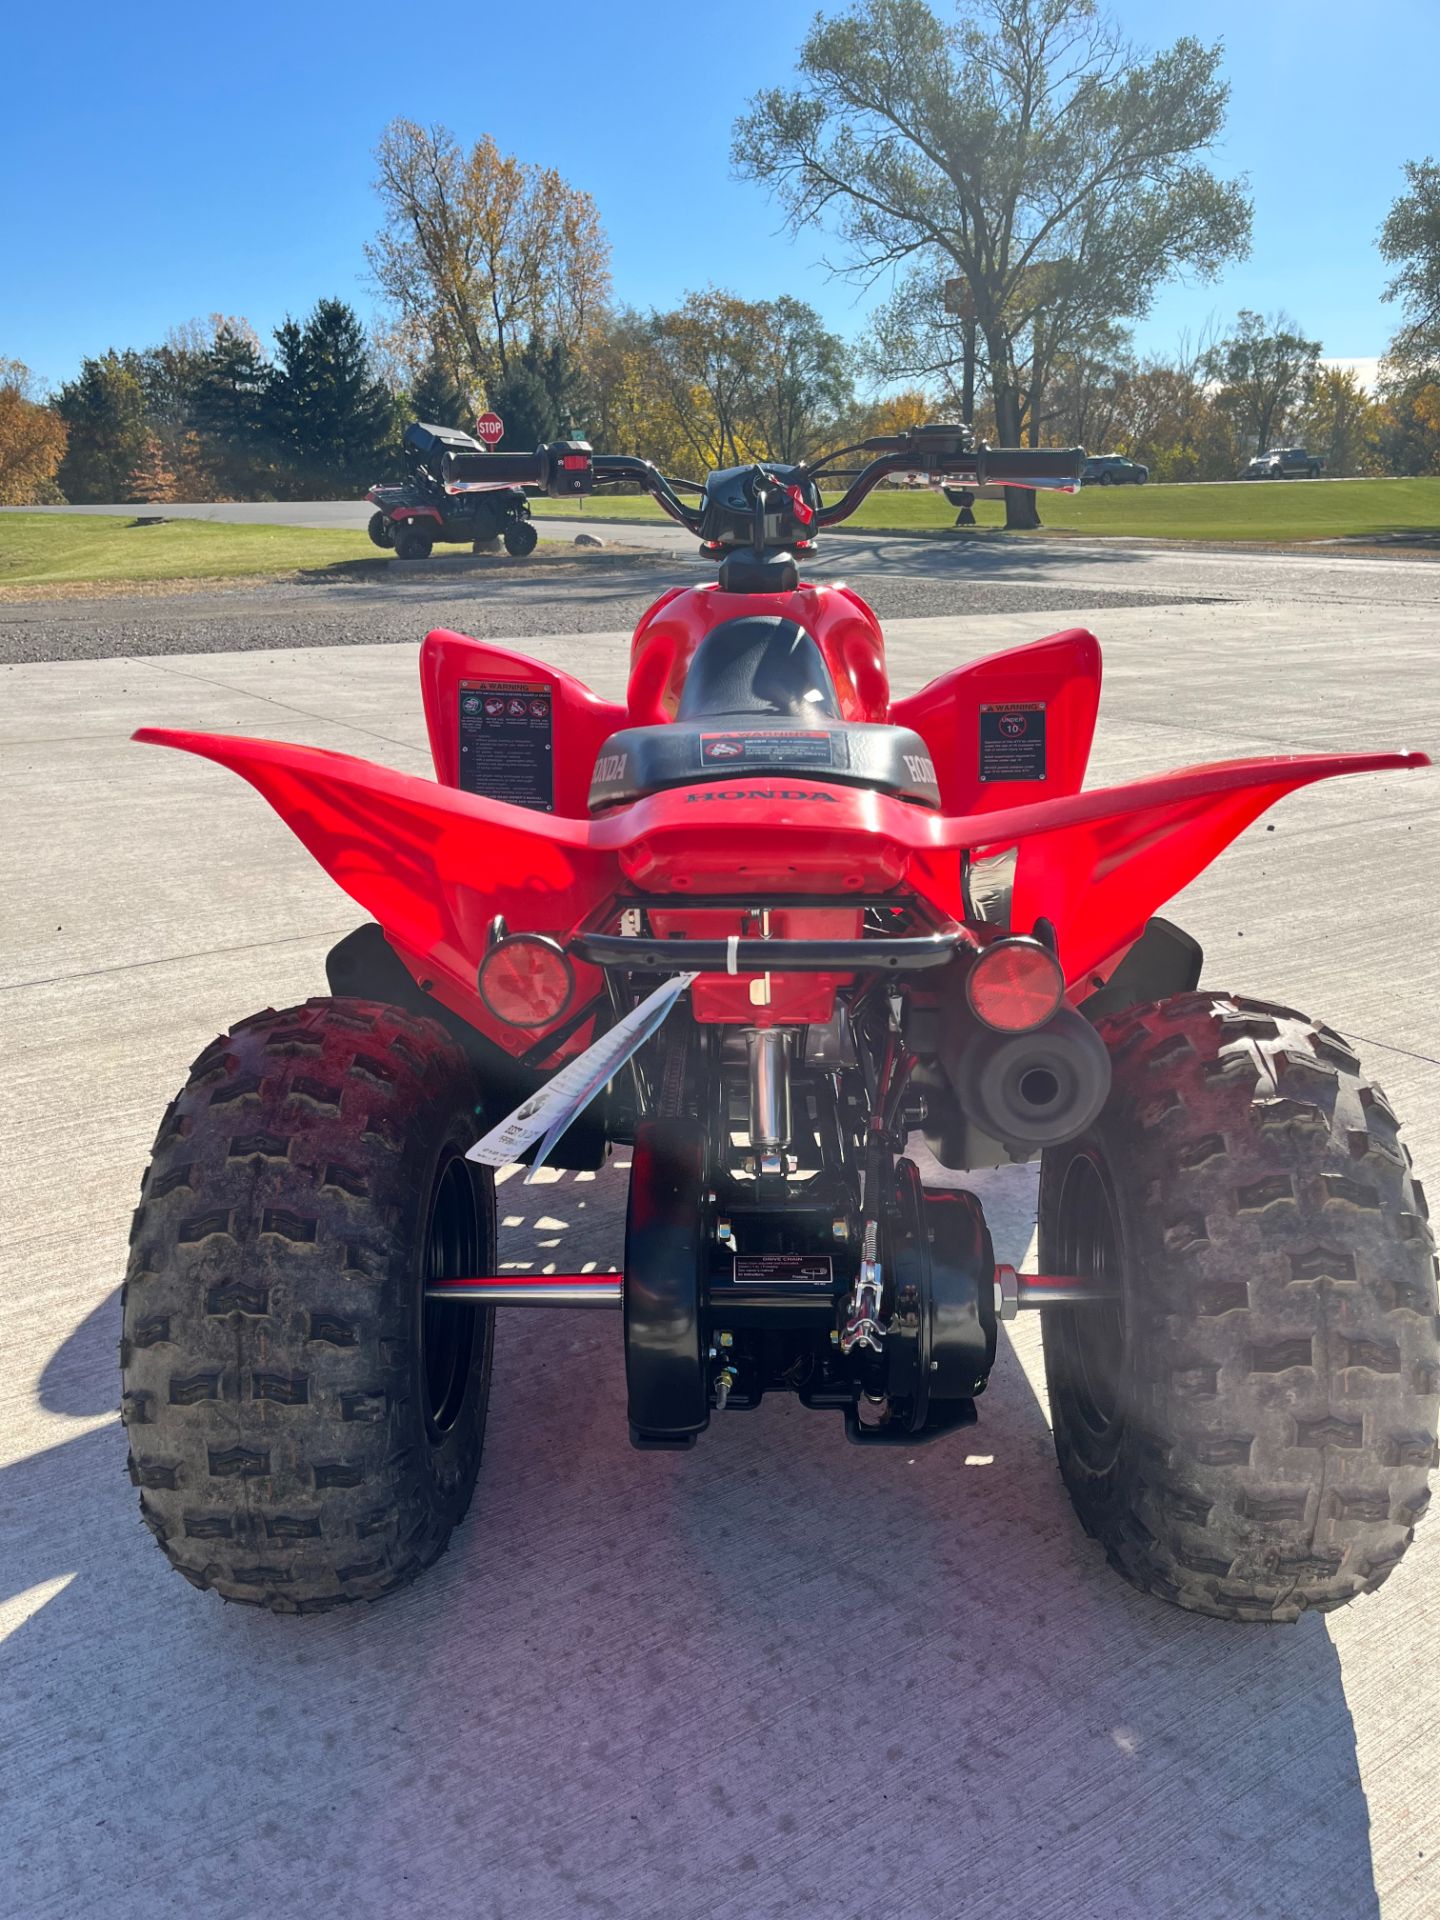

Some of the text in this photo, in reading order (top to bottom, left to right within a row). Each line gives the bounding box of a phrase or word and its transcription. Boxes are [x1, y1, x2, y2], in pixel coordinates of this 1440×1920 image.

[480, 422, 500, 434] STOP
[489, 682, 529, 690] WARNING
[996, 703, 1037, 711] WARNING
[1007, 725, 1019, 733] 10
[591, 753, 628, 784] ONDA
[685, 790, 841, 803] HONDA
